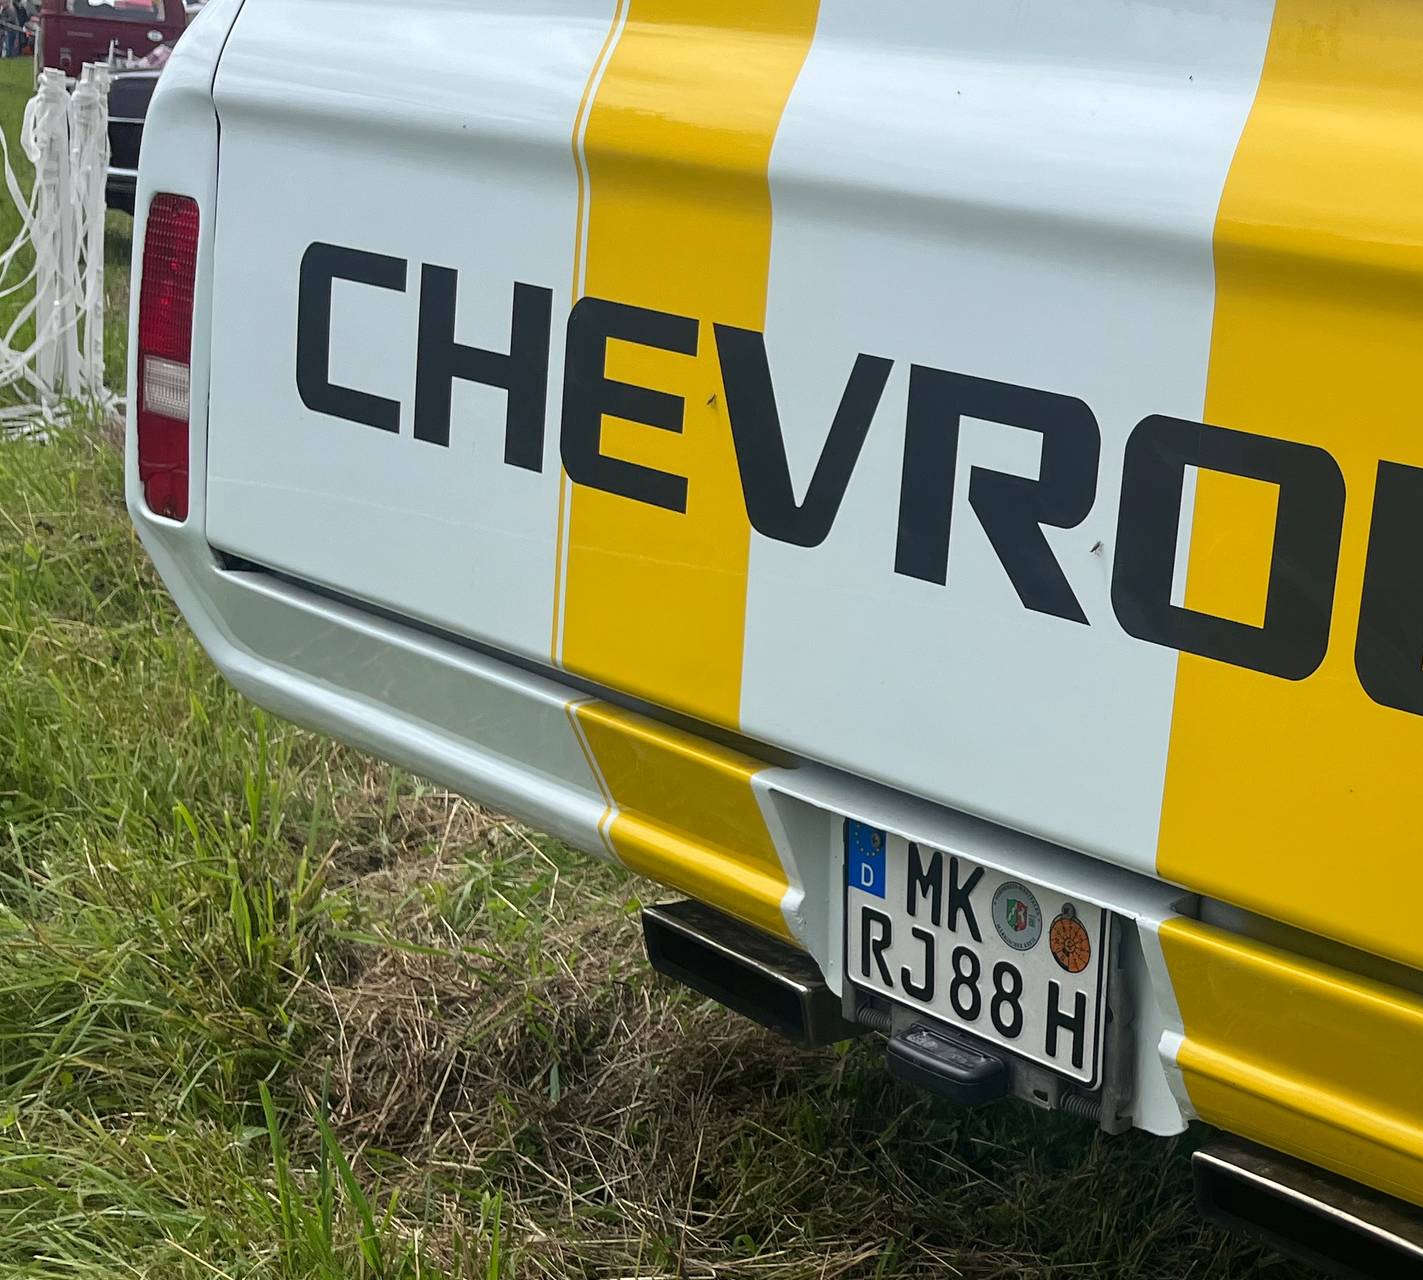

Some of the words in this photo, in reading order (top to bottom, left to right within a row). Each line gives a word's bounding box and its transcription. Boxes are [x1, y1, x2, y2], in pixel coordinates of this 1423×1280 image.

[861, 862, 874, 887] D
[906, 841, 985, 943] MK
[1045, 979, 1087, 1069] H
